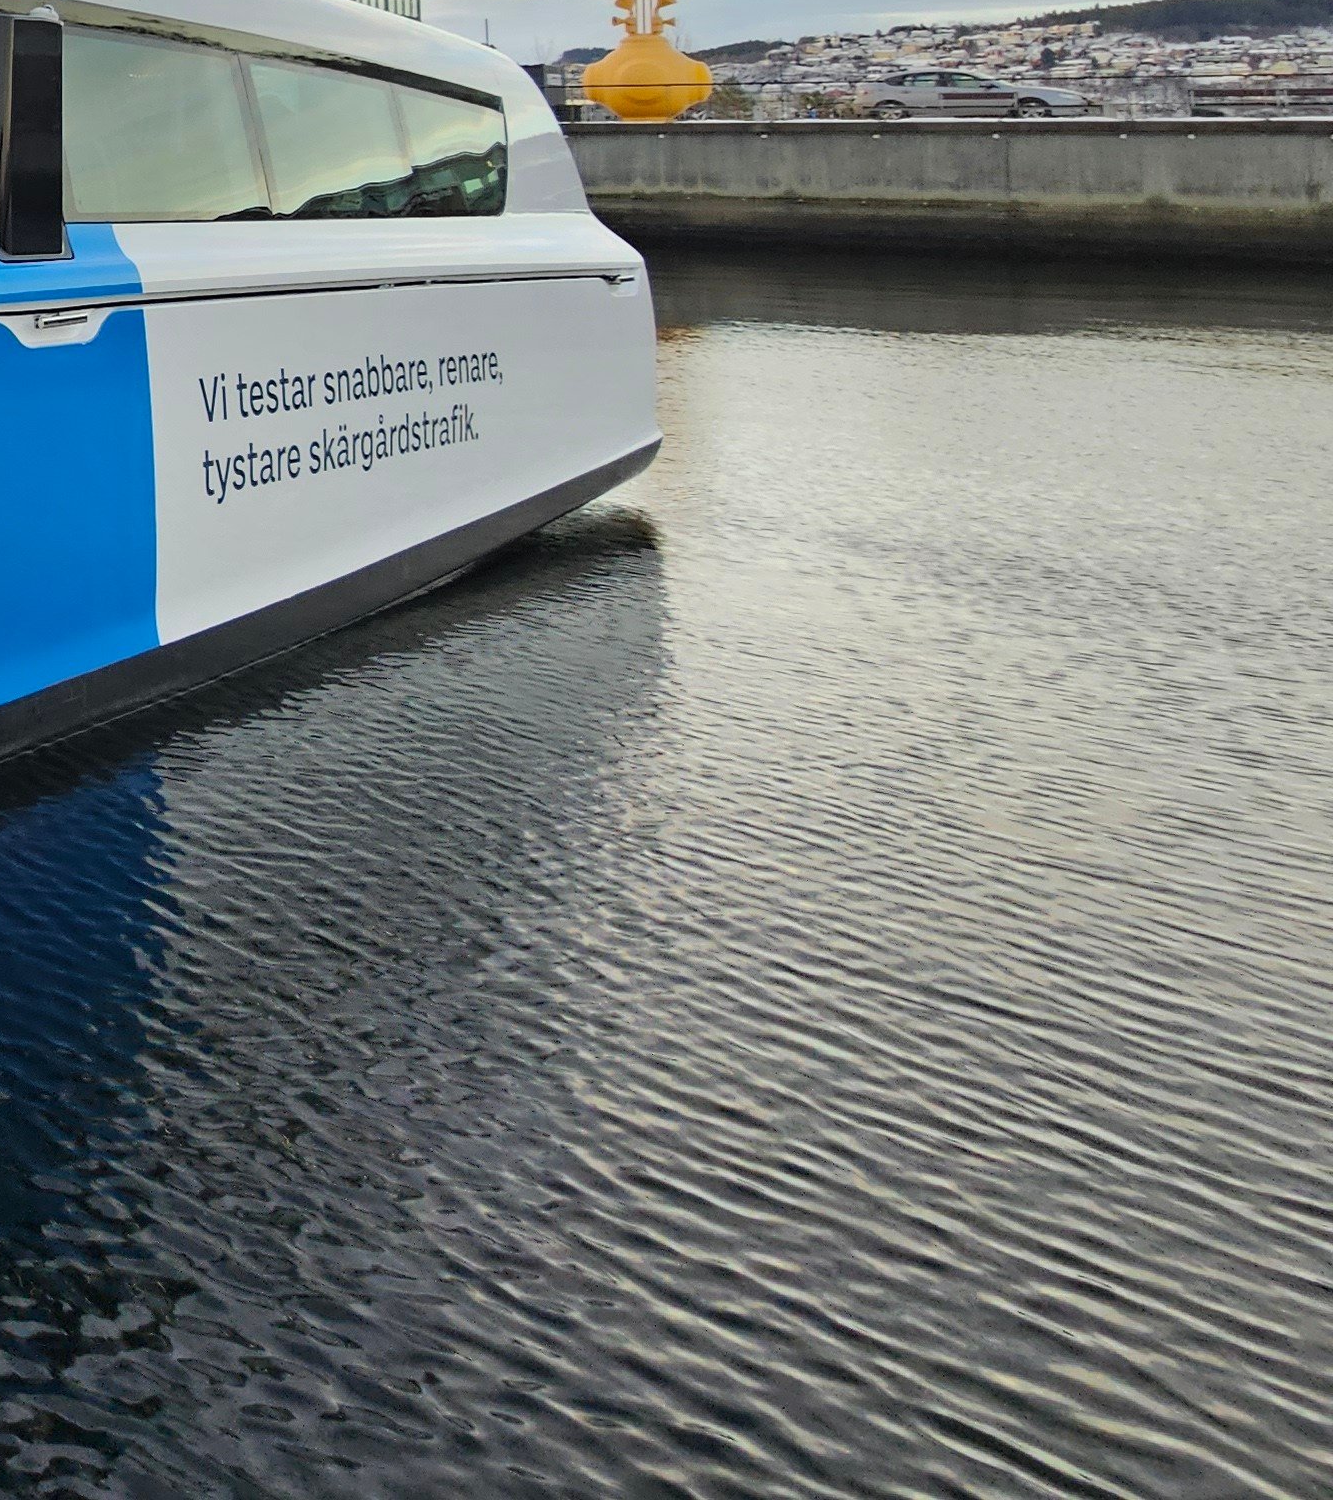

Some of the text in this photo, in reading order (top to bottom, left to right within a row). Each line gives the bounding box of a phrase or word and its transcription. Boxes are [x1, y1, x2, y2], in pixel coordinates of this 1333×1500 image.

[198, 350, 503, 423] Vi testar snabbare, renare,
[202, 402, 480, 505] tystare skärgårdstrafik.
